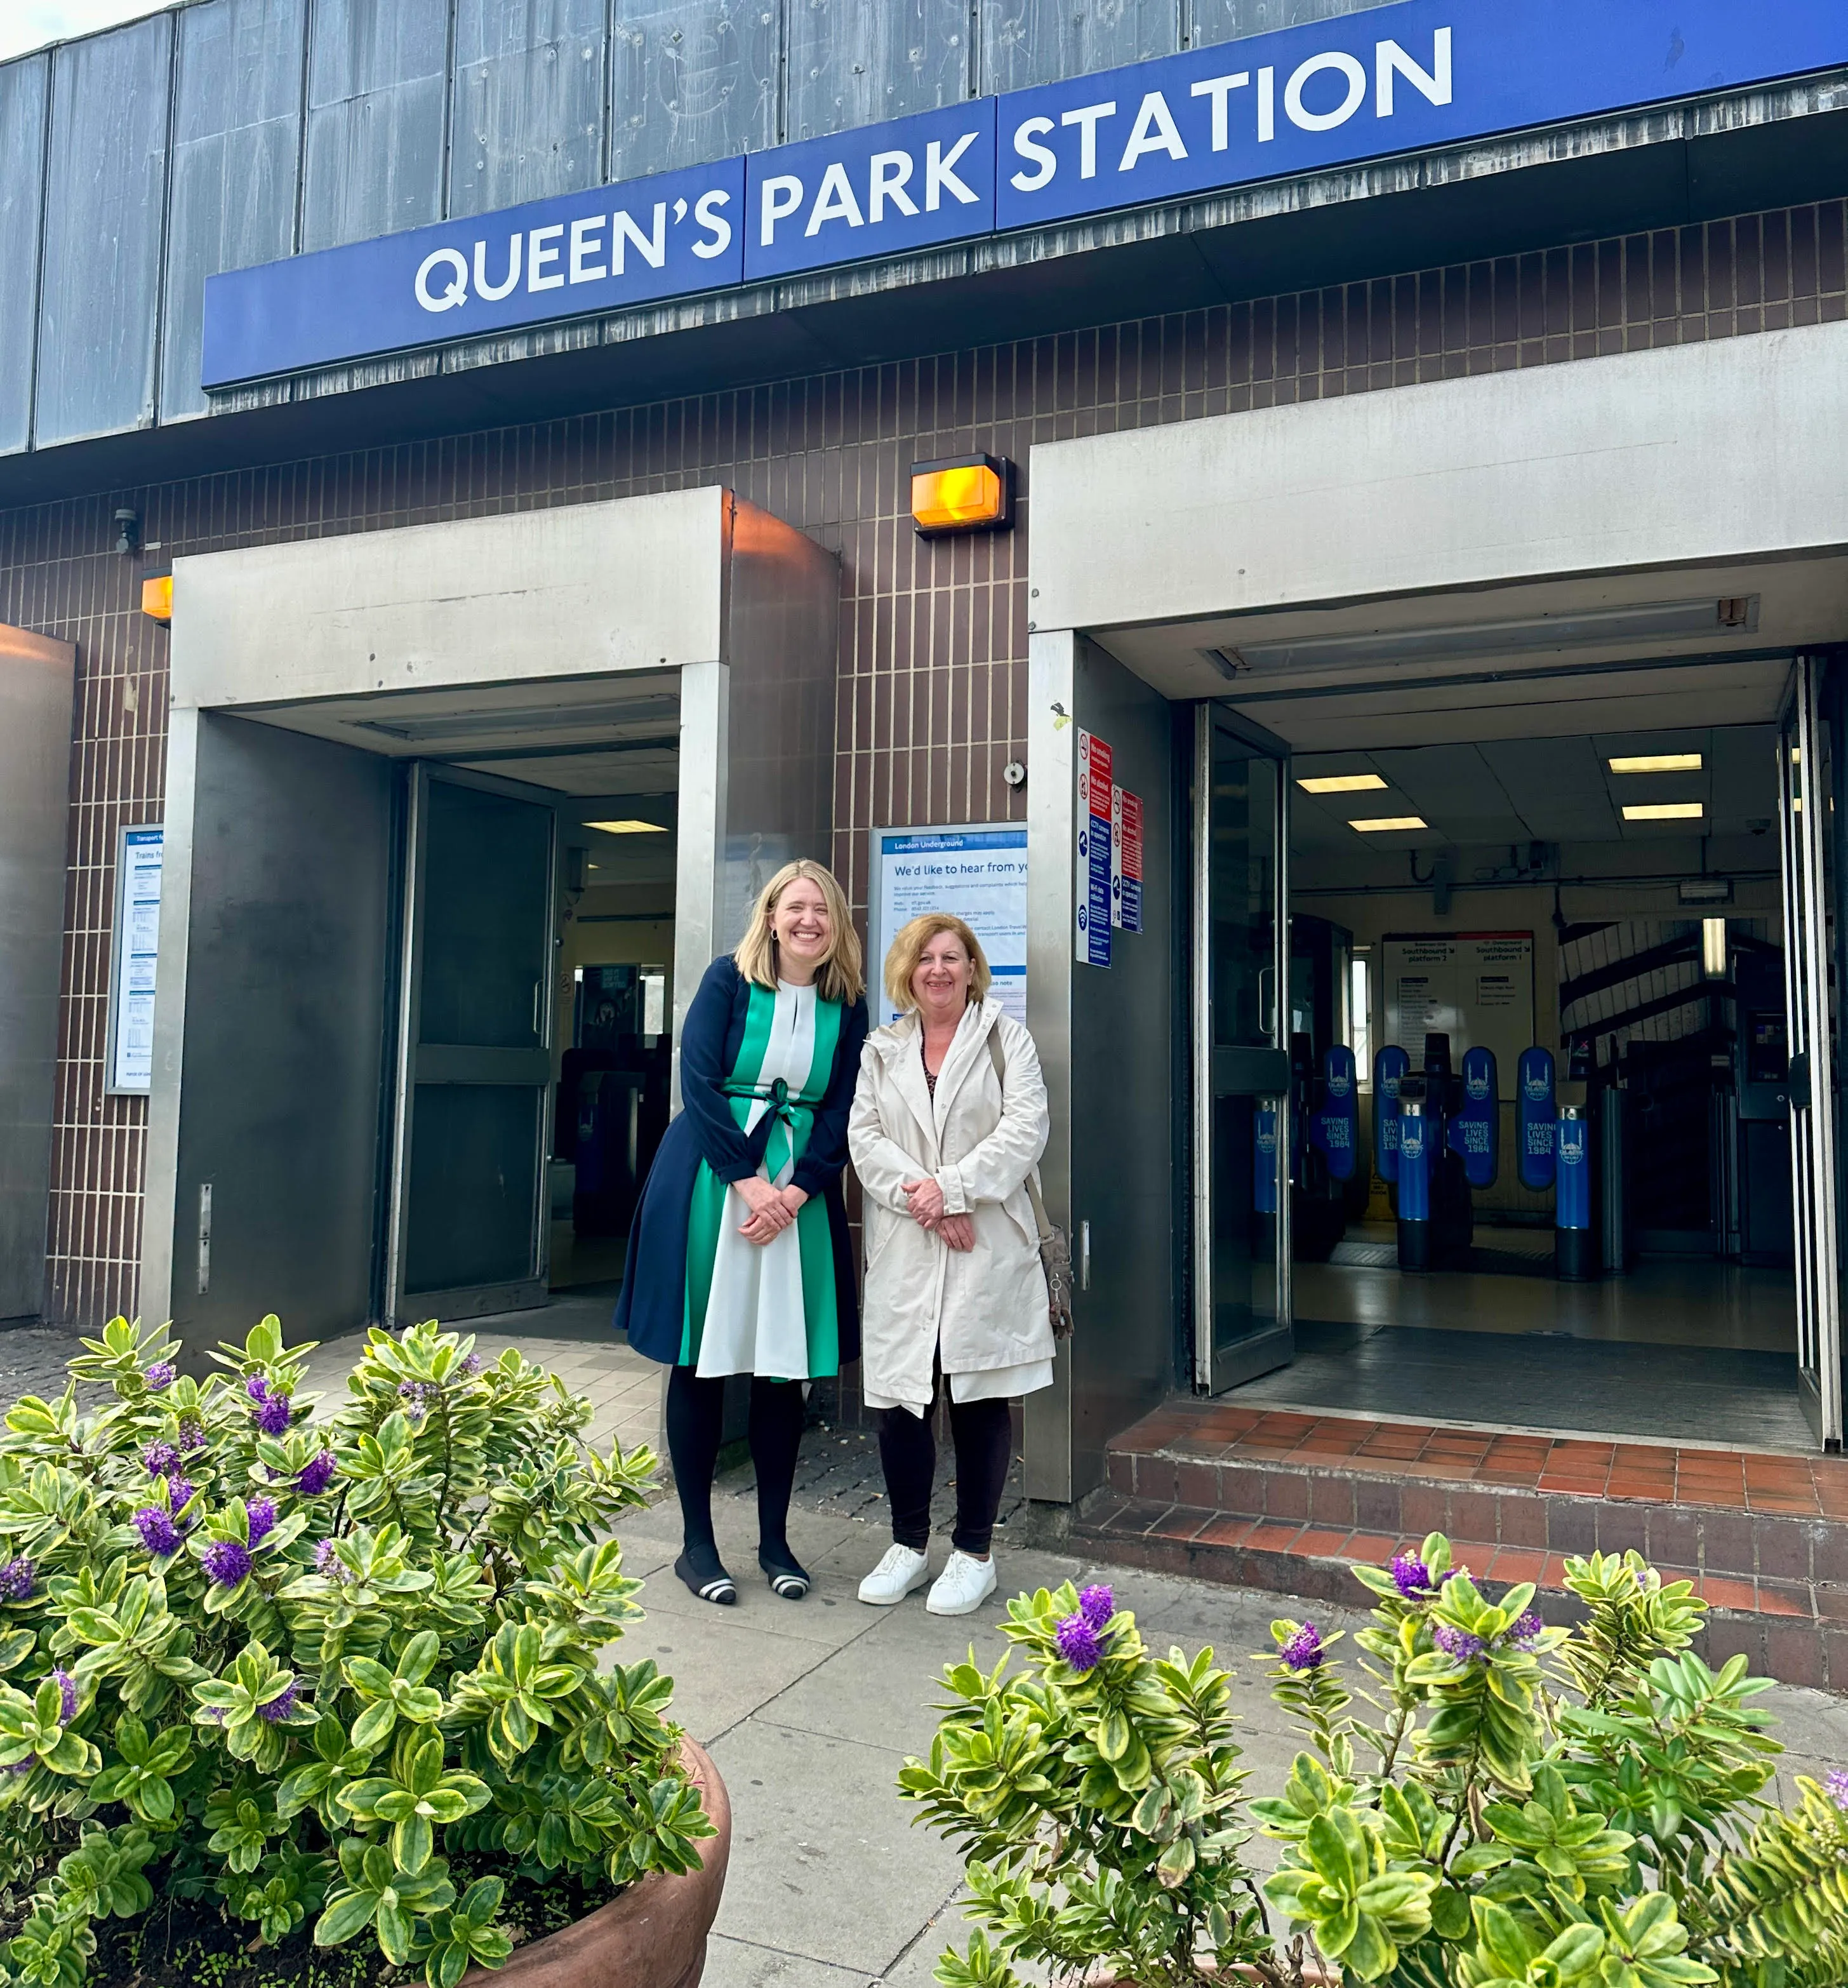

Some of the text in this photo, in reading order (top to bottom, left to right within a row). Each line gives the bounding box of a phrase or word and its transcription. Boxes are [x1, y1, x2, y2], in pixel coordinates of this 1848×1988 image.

[415, 26, 1452, 312] QUEEN'S PARK STATION
[921, 839, 964, 848] Underground
[135, 851, 154, 859] Trains
[894, 865, 921, 876] We'd
[924, 865, 943, 875] like
[947, 865, 957, 874] to
[961, 864, 985, 874] hear
[988, 862, 1015, 872] from
[1409, 955, 1441, 963] platform
[1483, 954, 1517, 962] platform
[1458, 1121, 1489, 1130] SAVING
[1326, 1132, 1350, 1140] SINCE
[1466, 1129, 1489, 1137] LIVES
[1527, 1130, 1553, 1139] LIVES
[1330, 1140, 1350, 1148] 1984
[1464, 1137, 1489, 1145] SINCE
[1527, 1138, 1554, 1147] SINCE
[1468, 1145, 1489, 1153] 1984
[1527, 1146, 1552, 1155] 1984
